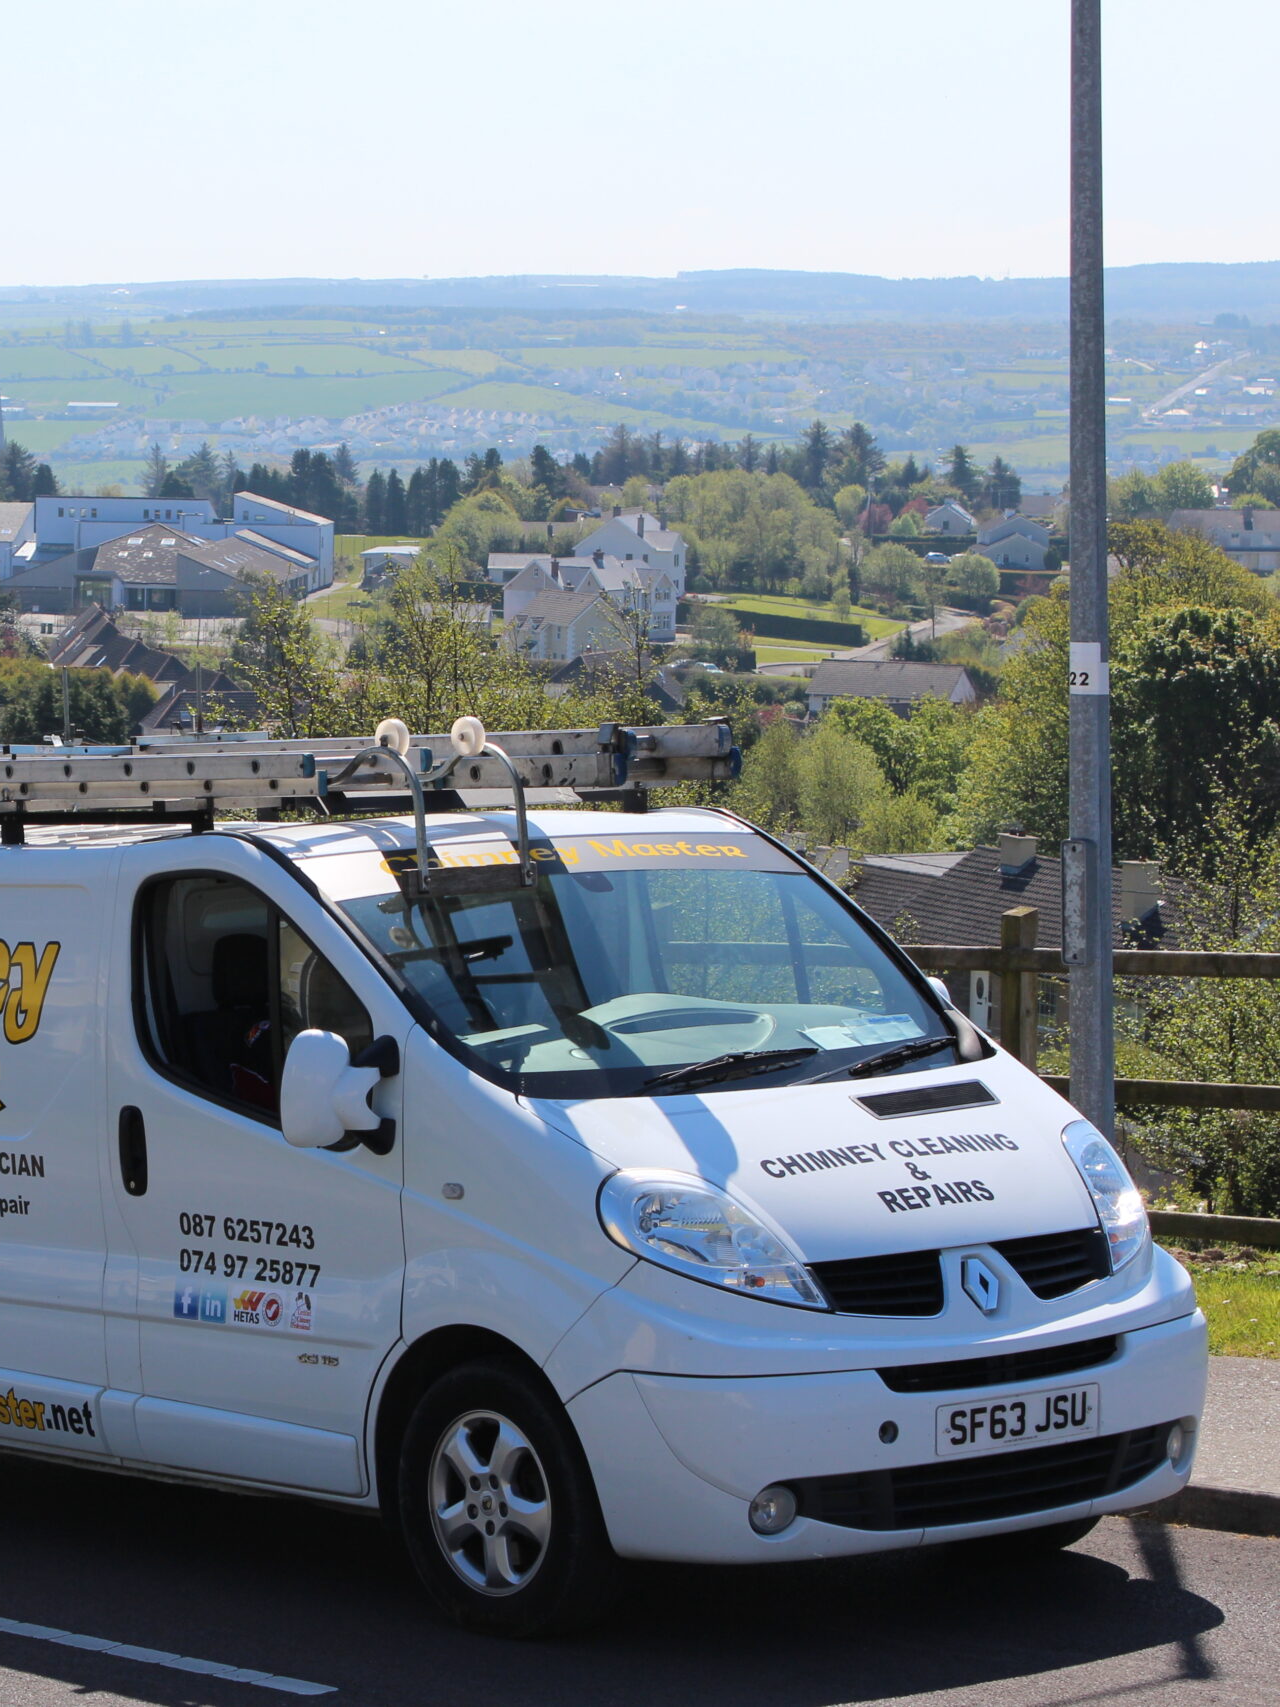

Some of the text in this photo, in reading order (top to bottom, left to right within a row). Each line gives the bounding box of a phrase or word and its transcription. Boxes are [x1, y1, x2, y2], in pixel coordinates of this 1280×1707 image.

[760, 1133, 1020, 1179] CHIMNEY CLEANING
[904, 1161, 932, 1181] &
[876, 1179, 995, 1213] REPAIRS
[179, 1212, 315, 1249] 087 6257243
[179, 1248, 321, 1288] 074 97 25877
[233, 1310, 260, 1325] HETAS
[950, 1391, 1087, 1446] SF63 JSU
